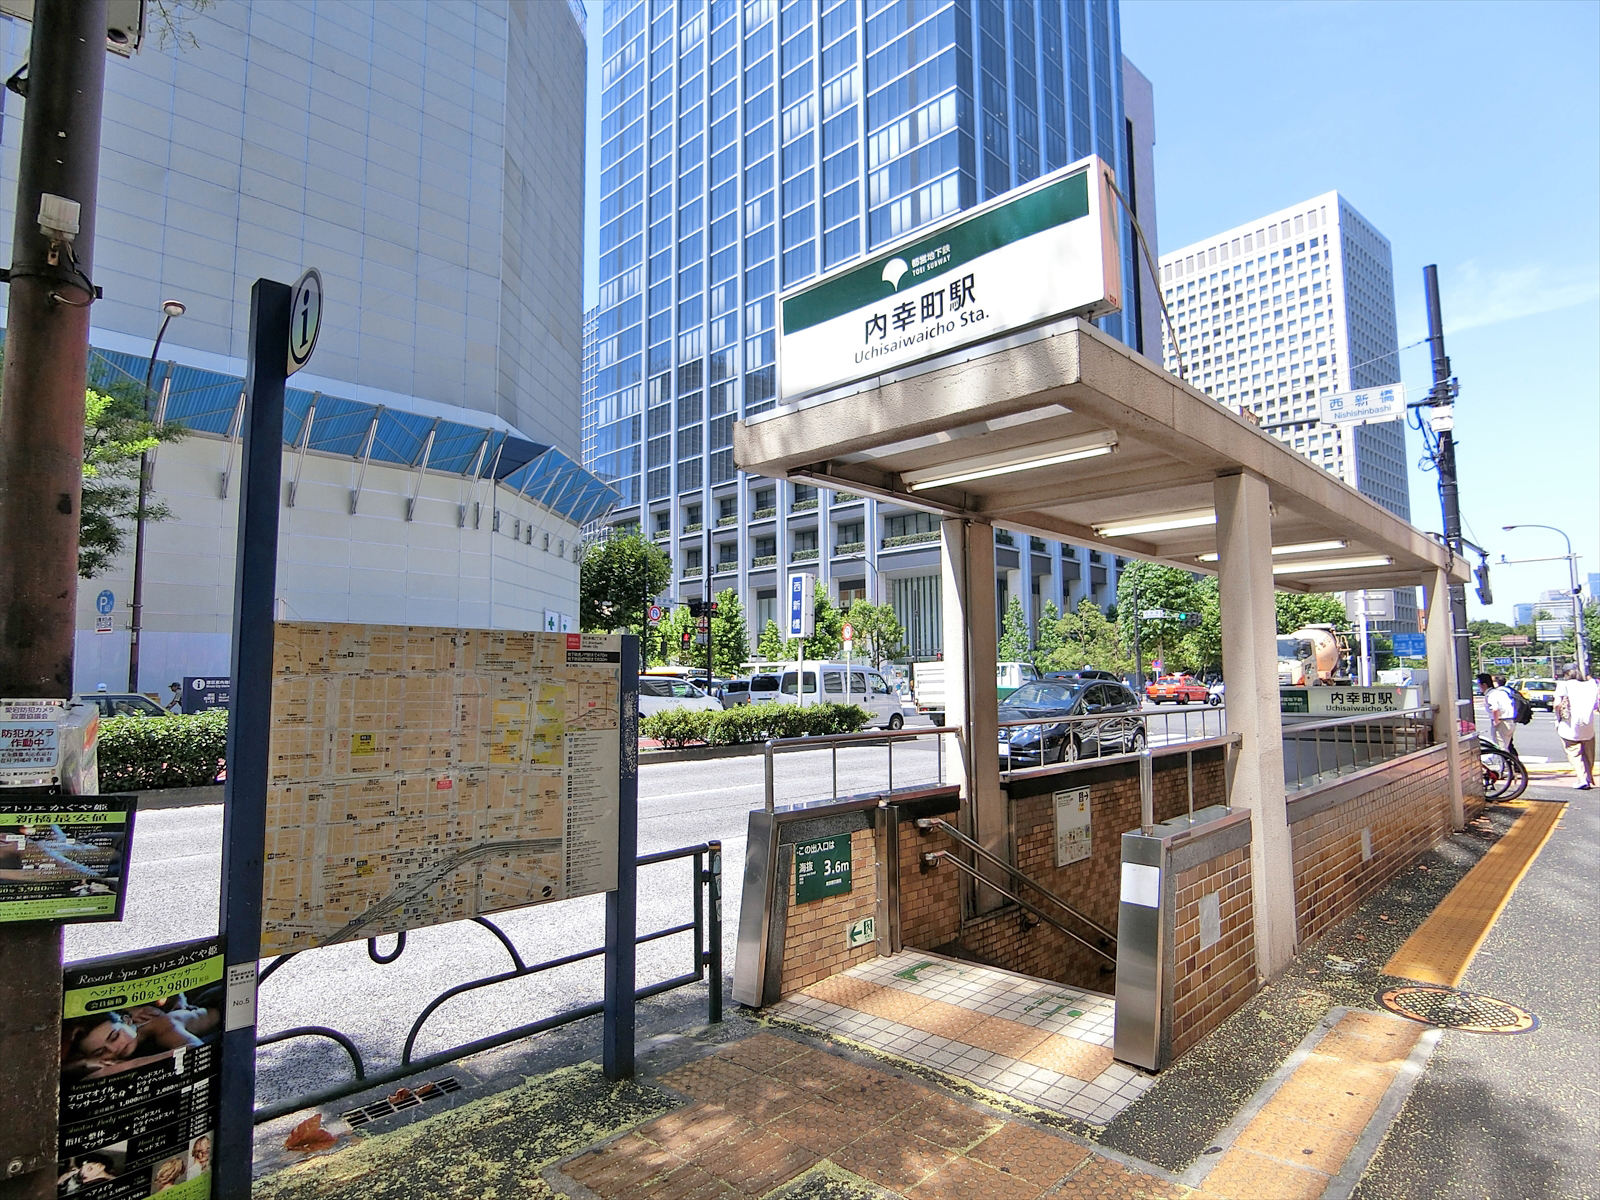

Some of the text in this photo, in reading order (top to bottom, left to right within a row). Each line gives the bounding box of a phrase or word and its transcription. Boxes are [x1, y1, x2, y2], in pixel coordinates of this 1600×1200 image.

[911, 244, 951, 268] 都営地下鉄
[912, 254, 951, 277] TOEI SUBWAY
[865, 273, 976, 344] 内幸町駅
[854, 308, 990, 364] Uchisaiwaicho Sta.
[1329, 389, 1395, 411] 西新橋
[1334, 404, 1392, 420] Nishishinbashi
[1331, 692, 1393, 704] 内幸町駅
[1, 728, 54, 738] 防犯カメラ
[11, 738, 44, 748] 作動中
[16, 814, 108, 823] 新橋最安値
[798, 841, 835, 855] この出入口は
[824, 860, 849, 876] 3.6m
[77, 944, 218, 985] Resort Spa アトリエかぐや姫
[233, 997, 250, 1006] No.5
[68, 1086, 115, 1101] アロマオイル
